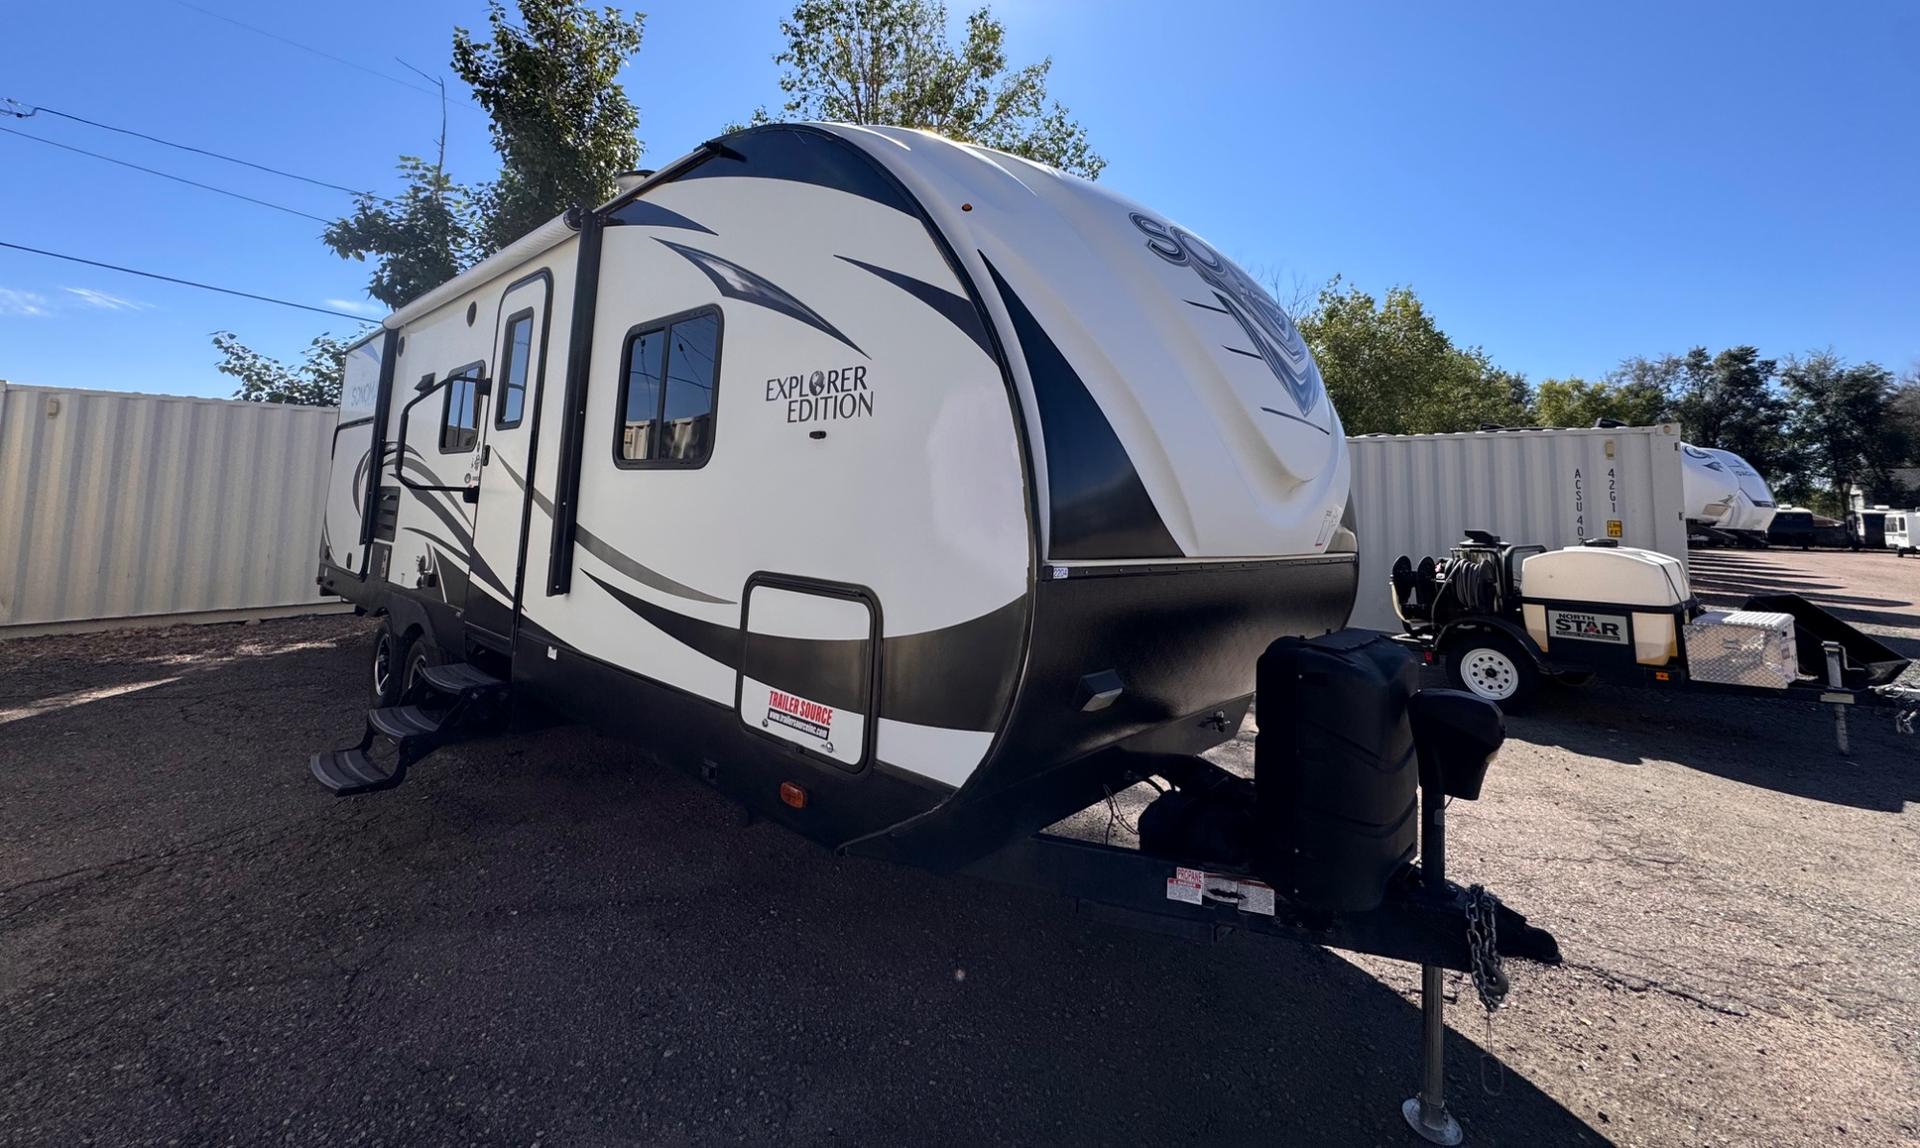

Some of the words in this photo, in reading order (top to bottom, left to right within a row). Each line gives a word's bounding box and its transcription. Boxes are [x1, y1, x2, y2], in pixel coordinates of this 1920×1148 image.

[765, 366, 868, 401] EXPLORER
[787, 391, 874, 423] EDITION
[1574, 468, 1583, 512] ACSU
[1607, 468, 1616, 513] 42G1
[1555, 618, 1620, 636] STAR
[1558, 613, 1595, 621] NORTH
[769, 691, 800, 715] TRAILER
[799, 700, 833, 726] SOURCE
[1177, 868, 1203, 884] PROPANE
